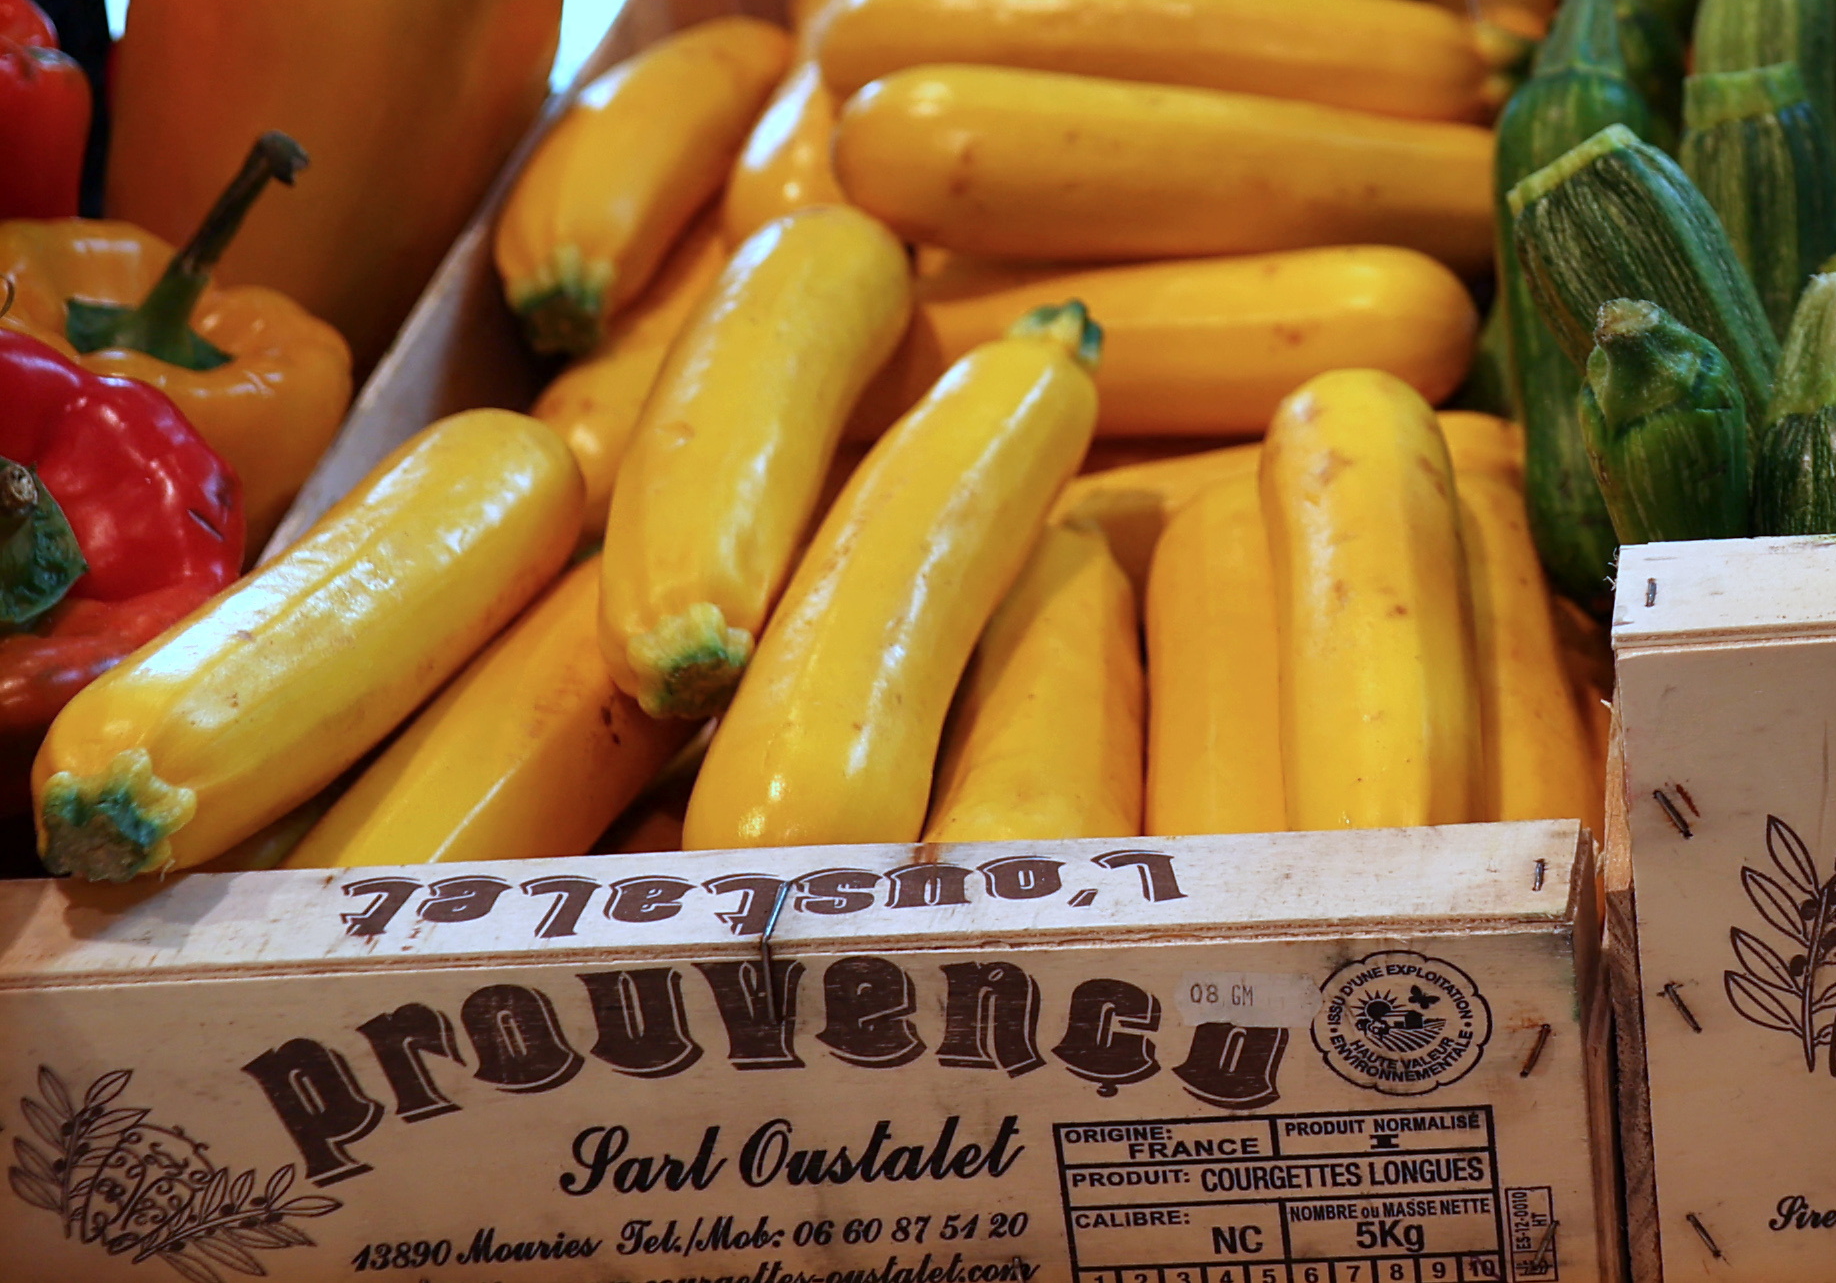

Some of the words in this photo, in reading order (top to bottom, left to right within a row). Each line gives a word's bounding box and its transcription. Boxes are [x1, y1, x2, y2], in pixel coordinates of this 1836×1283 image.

[1231, 984, 1254, 1007] GM
[1328, 995, 1346, 1026] ISSU
[1341, 966, 1384, 997] D'UNE
[1386, 964, 1474, 1020] EXPLOITATION
[1329, 1029, 1474, 1083] ENVIRONNEMENTALE
[1350, 1039, 1398, 1070] HAUTE
[1400, 1036, 1455, 1070] VALEUR
[1064, 1126, 1173, 1145] ORIGINE:
[1284, 1119, 1365, 1137] PRODUIT
[1374, 1112, 1481, 1133] NORMALISÉ
[560, 1125, 728, 1197] Sarl
[738, 1115, 1027, 1189] Oustalet
[1128, 1137, 1261, 1160] FRANCE
[1072, 1168, 1191, 1188] PRODUIT:
[1200, 1161, 1362, 1193] COURGETTES
[1368, 1156, 1485, 1186] LONGUES
[1074, 1209, 1191, 1229] CALIBRE:
[1290, 1202, 1357, 1223] NOMBRE
[1361, 1206, 1380, 1219] ou
[1382, 1200, 1436, 1219] MASSE
[1440, 1197, 1491, 1215] NETTE
[1532, 1211, 1549, 1228] HT
[351, 1239, 451, 1273] 13890
[456, 1227, 603, 1266] Mouries
[793, 1220, 834, 1247] 06
[843, 1217, 883, 1245] 60
[891, 1215, 932, 1244] 87
[940, 1213, 980, 1241] 51
[988, 1211, 1029, 1239] 20
[1212, 1224, 1264, 1255] NC
[1356, 1218, 1425, 1253] 5Kg
[1262, 1269, 1277, 1283] 5
[1304, 1267, 1319, 1283] 6
[1346, 1265, 1361, 1283] 7
[1390, 1263, 1405, 1281] 8
[1432, 1262, 1446, 1279] 9
[1471, 1256, 1495, 1277] 10
